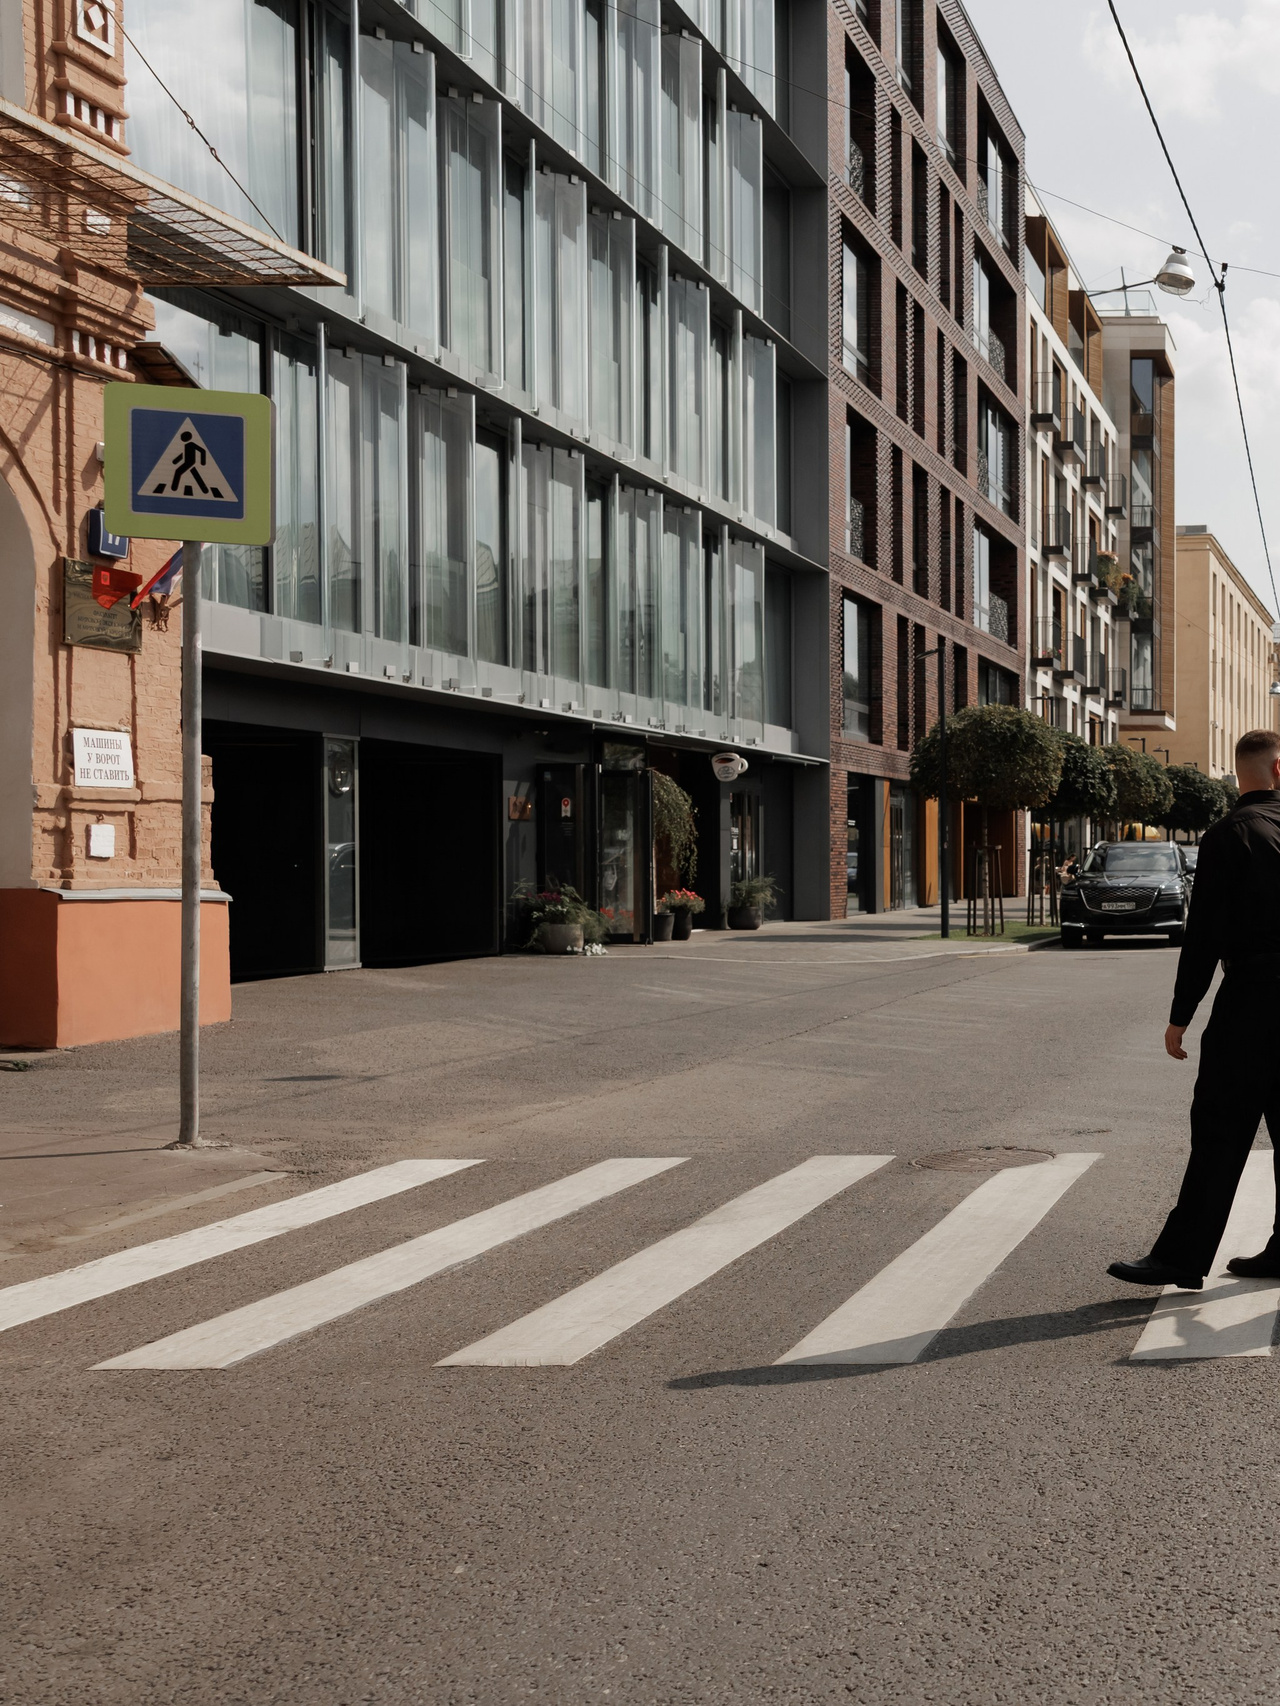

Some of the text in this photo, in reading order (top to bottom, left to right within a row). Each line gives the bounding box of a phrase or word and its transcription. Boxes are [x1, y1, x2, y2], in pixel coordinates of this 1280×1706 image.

[83, 737, 122, 750] МАШИНЫ
[87, 753, 120, 765] У ВОРОТ
[80, 768, 129, 780] НЕ СТАВИТЬ
